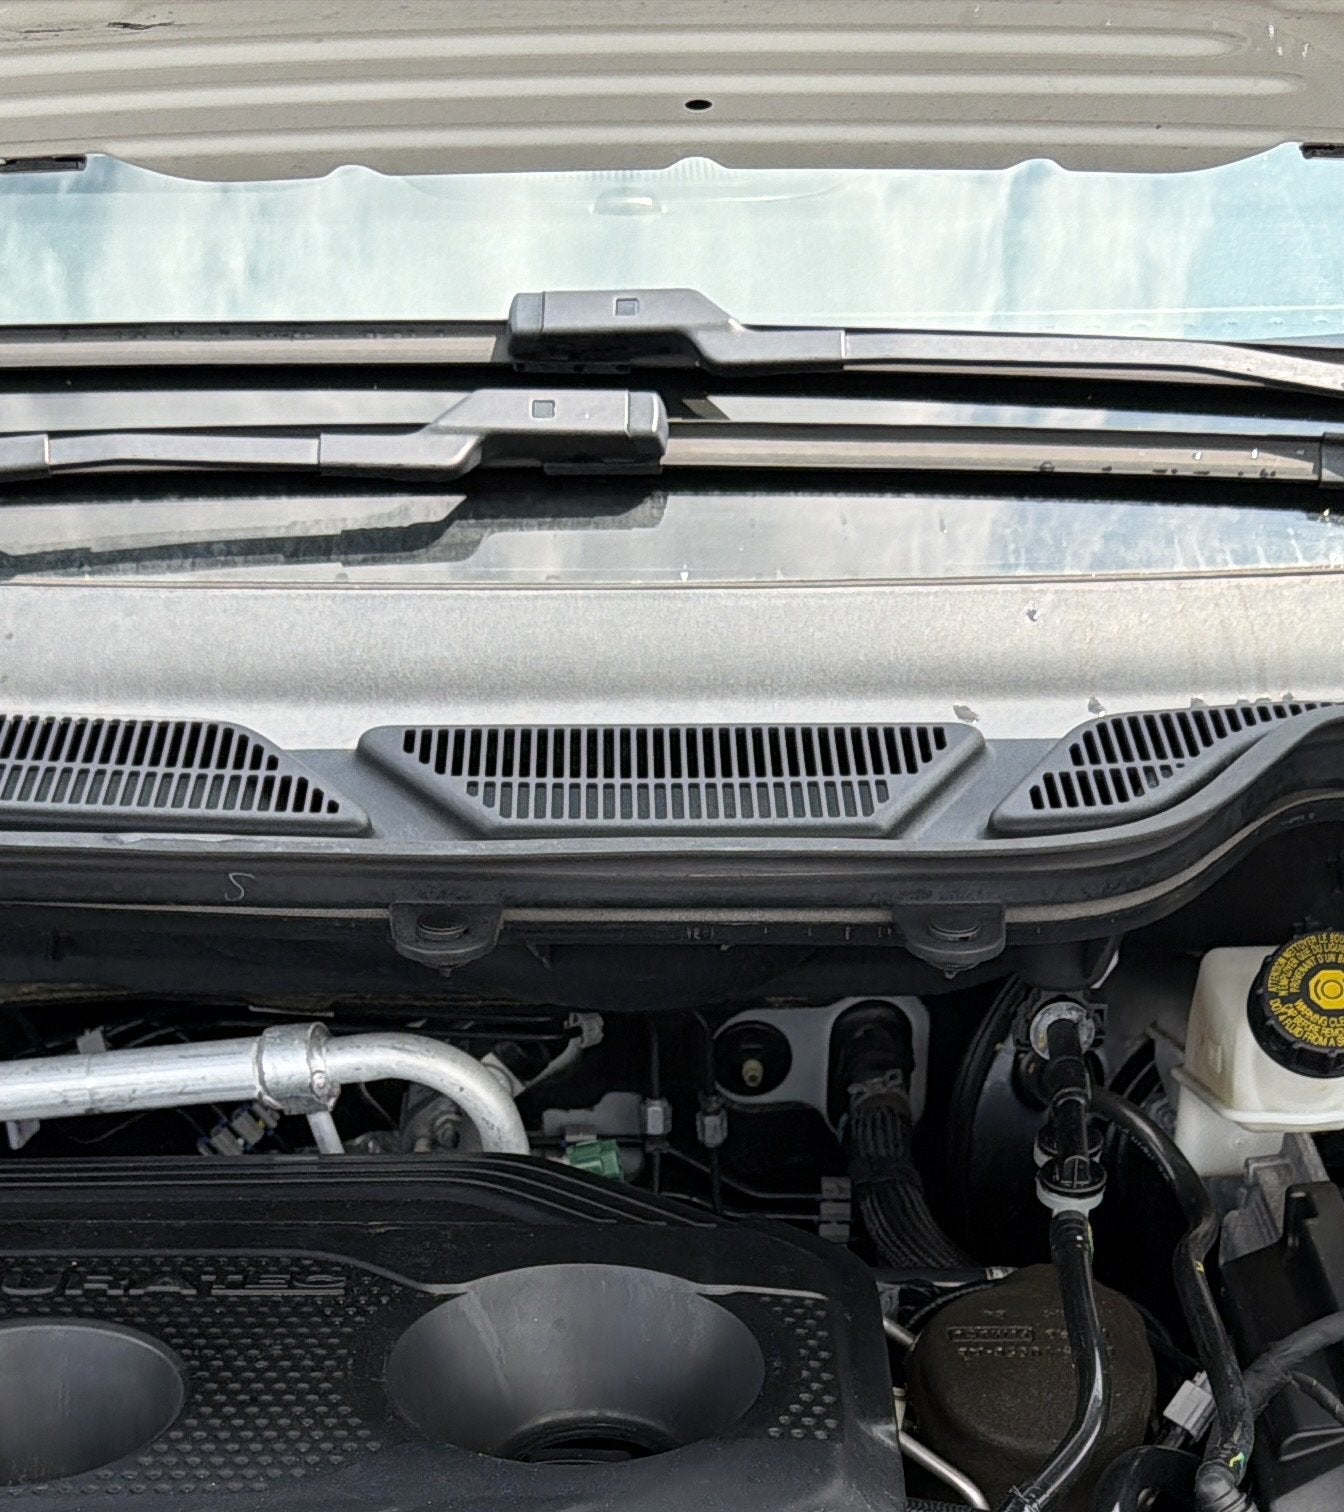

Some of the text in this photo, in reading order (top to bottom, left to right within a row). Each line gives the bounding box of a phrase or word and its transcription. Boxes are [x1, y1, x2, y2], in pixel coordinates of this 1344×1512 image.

[1267, 955, 1288, 992] ATTENTION
[1280, 933, 1317, 960] NETTOYER
[1316, 931, 1328, 942] LE
[1294, 946, 1312, 961] QUE
[1309, 942, 1323, 954] DU
[1289, 954, 1318, 992] PROVENANT
[1314, 951, 1336, 963] D'UN
[1269, 997, 1285, 1016] DOT
[1280, 1017, 1305, 1039] FLUID
[1301, 1031, 1328, 1046] FROM
[1282, 1001, 1299, 1019] CAP
[1291, 1013, 1321, 1035] BEFORE
[1291, 997, 1328, 1027] WARNING
